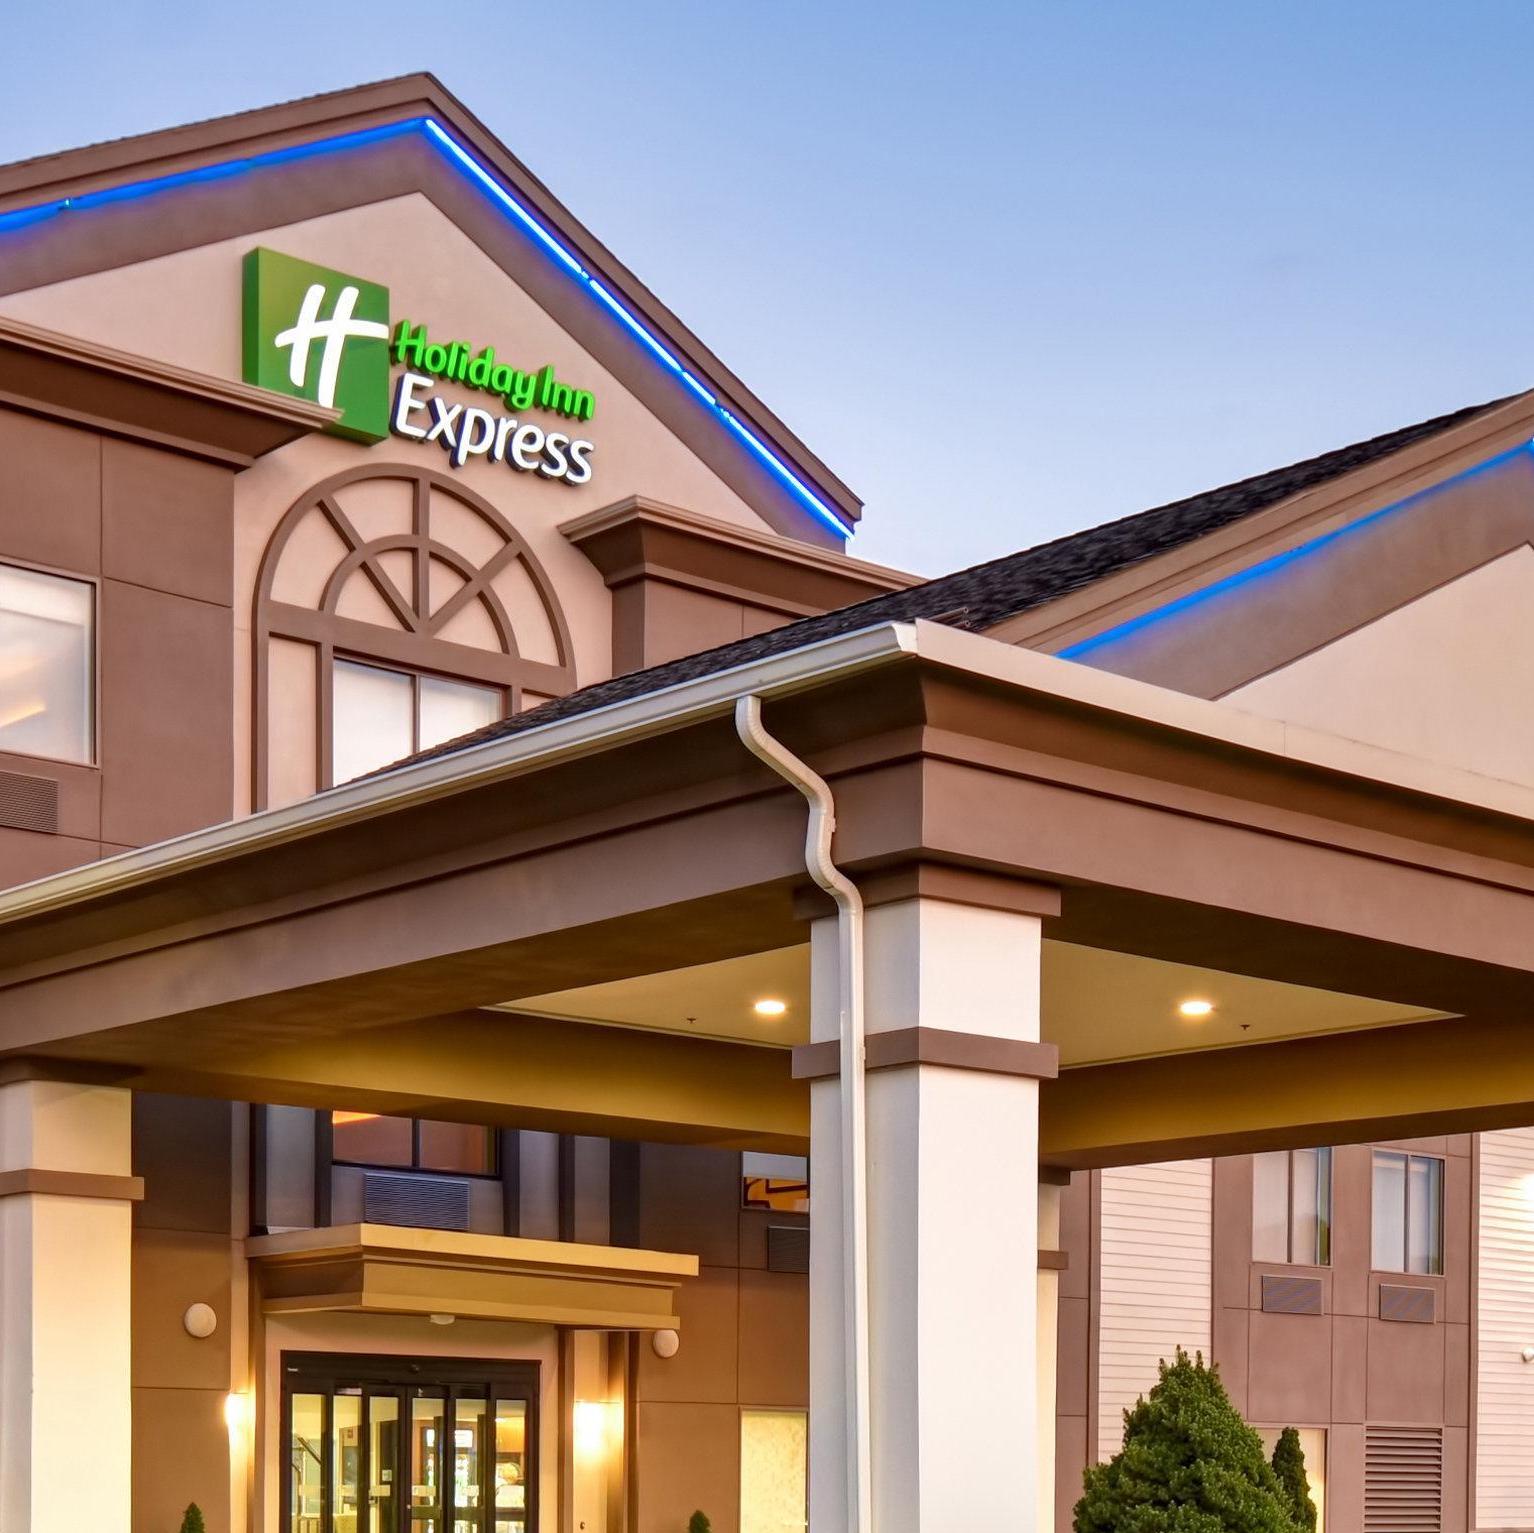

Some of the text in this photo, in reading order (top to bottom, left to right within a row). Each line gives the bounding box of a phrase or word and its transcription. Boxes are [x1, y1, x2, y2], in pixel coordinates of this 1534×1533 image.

[394, 319, 596, 421] Holiday Inn
[393, 371, 596, 485] Express
